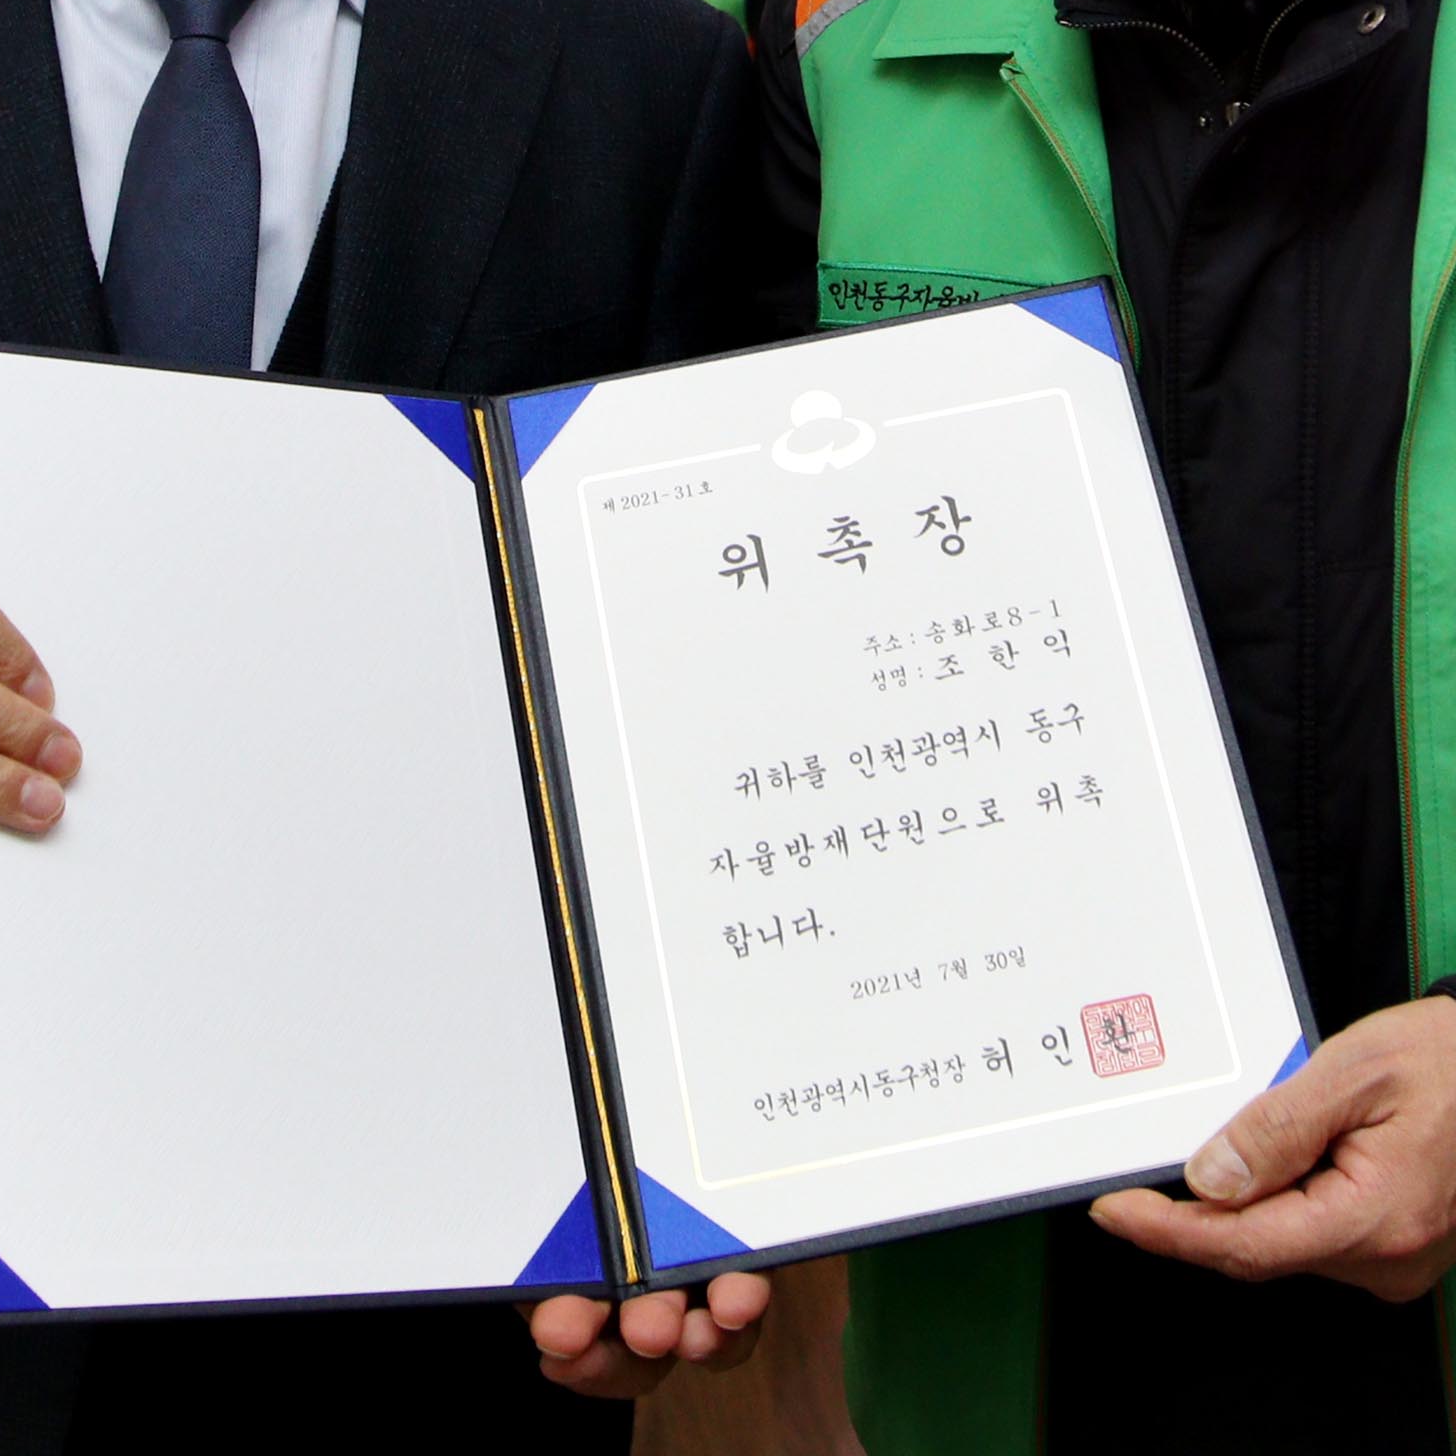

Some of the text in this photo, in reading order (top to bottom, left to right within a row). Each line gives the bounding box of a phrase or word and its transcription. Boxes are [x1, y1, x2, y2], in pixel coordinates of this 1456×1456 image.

[734, 702, 1087, 800] 귀하를 인천광역시 동구
[709, 774, 1105, 883] 자율방재단원으로 위촉
[722, 907, 837, 959] 합니다.
[850, 945, 1028, 1001] 2021년 7월 30일
[753, 1053, 967, 1123] 인천광역시동구청장
